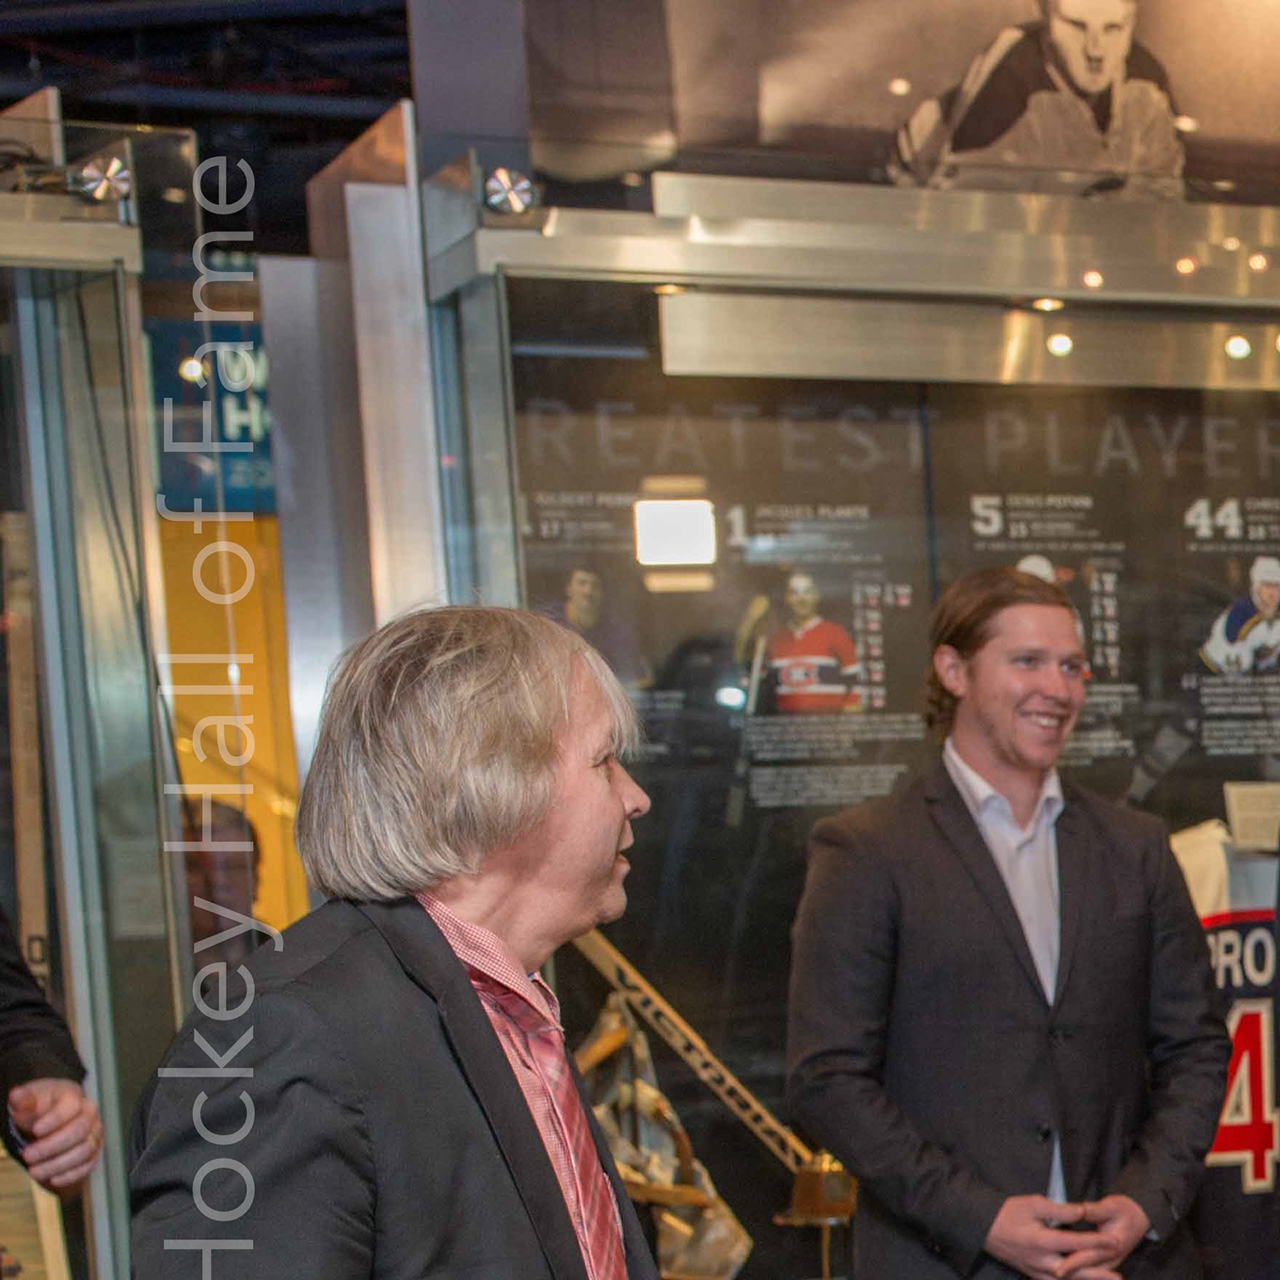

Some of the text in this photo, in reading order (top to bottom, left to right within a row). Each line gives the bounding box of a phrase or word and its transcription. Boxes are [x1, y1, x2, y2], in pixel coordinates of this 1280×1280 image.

[726, 505, 748, 546] 1
[969, 494, 1003, 537] 5
[1184, 498, 1243, 539] 44
